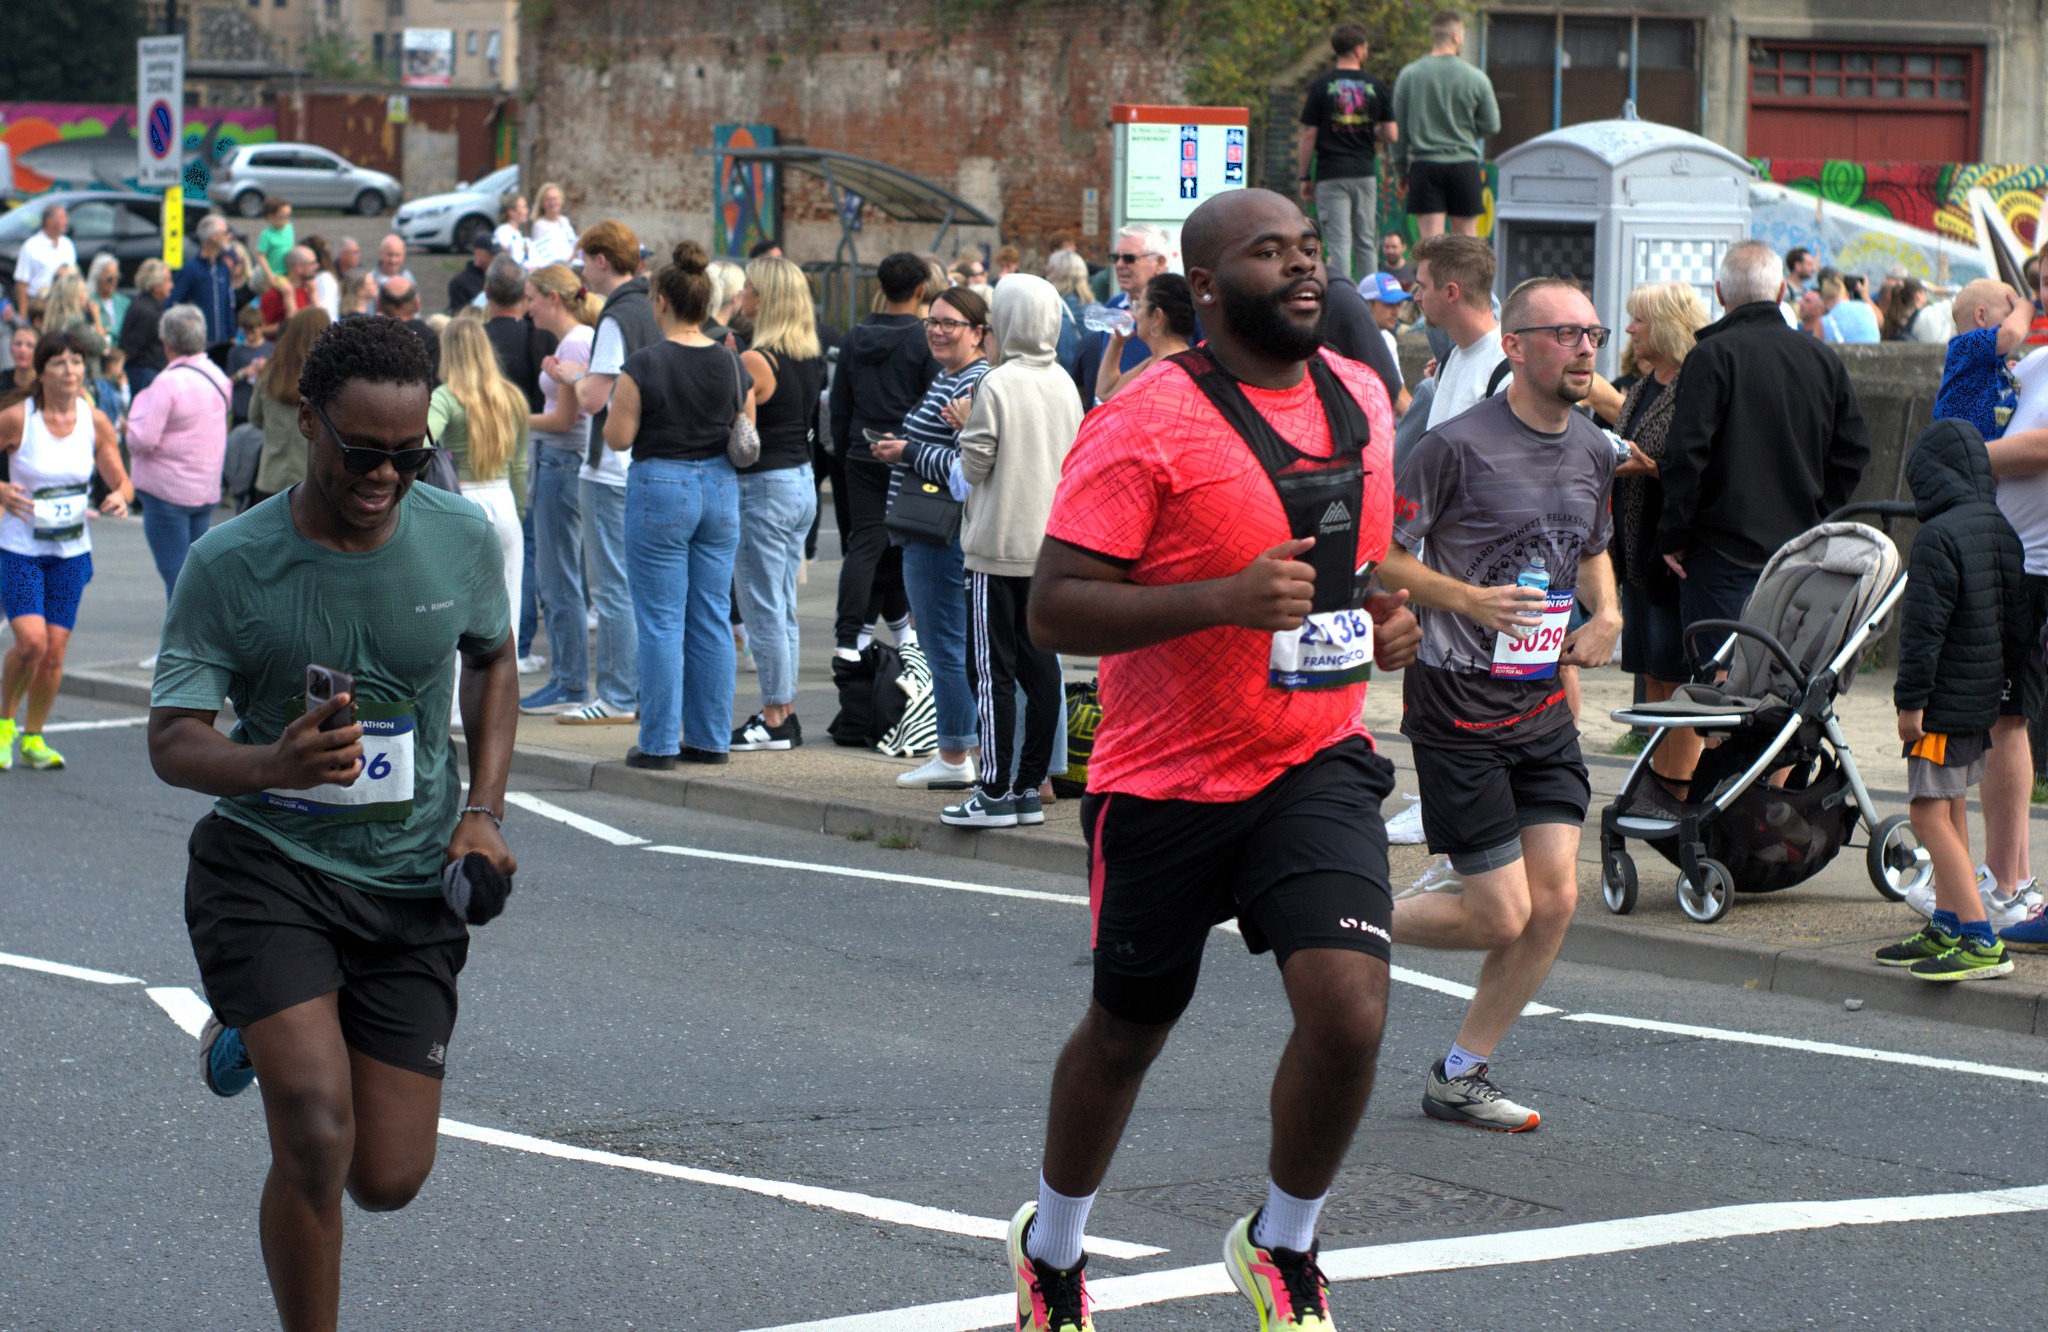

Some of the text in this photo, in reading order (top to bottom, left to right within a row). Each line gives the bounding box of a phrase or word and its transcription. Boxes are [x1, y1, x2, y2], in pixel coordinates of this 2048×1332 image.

[54, 503, 72, 518] 73
[1461, 545, 1495, 582] ICHARD
[1495, 517, 1542, 548] BENNETT
